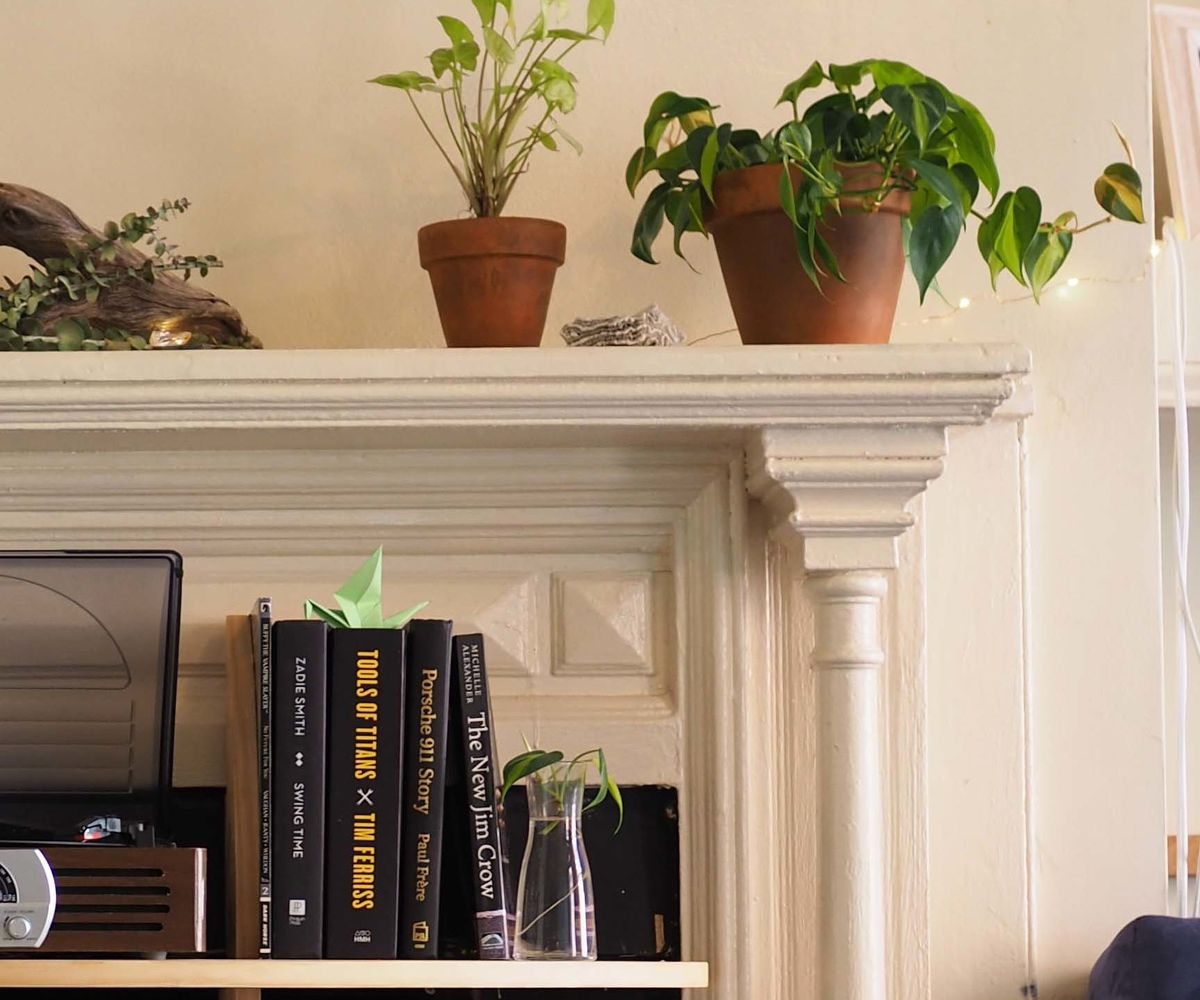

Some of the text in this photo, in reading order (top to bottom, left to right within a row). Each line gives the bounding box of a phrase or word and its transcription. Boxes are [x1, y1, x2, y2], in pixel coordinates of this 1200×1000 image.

[262, 644, 270, 657] THE
[262, 657, 270, 684] VAMPIRE
[462, 644, 473, 704] ALEXANDER
[471, 644, 482, 696] MICHELLE
[294, 657, 306, 736] ZADIE SMITH
[354, 649, 379, 779] TOOLS OF TITANS
[413, 668, 438, 814] Porsche 911 Story
[292, 782, 305, 858] SWING TIME
[353, 813, 376, 841] TIM
[467, 712, 496, 899] The New Jim Crow
[352, 846, 375, 909] FERRISS
[415, 833, 431, 902] Paul Frère
